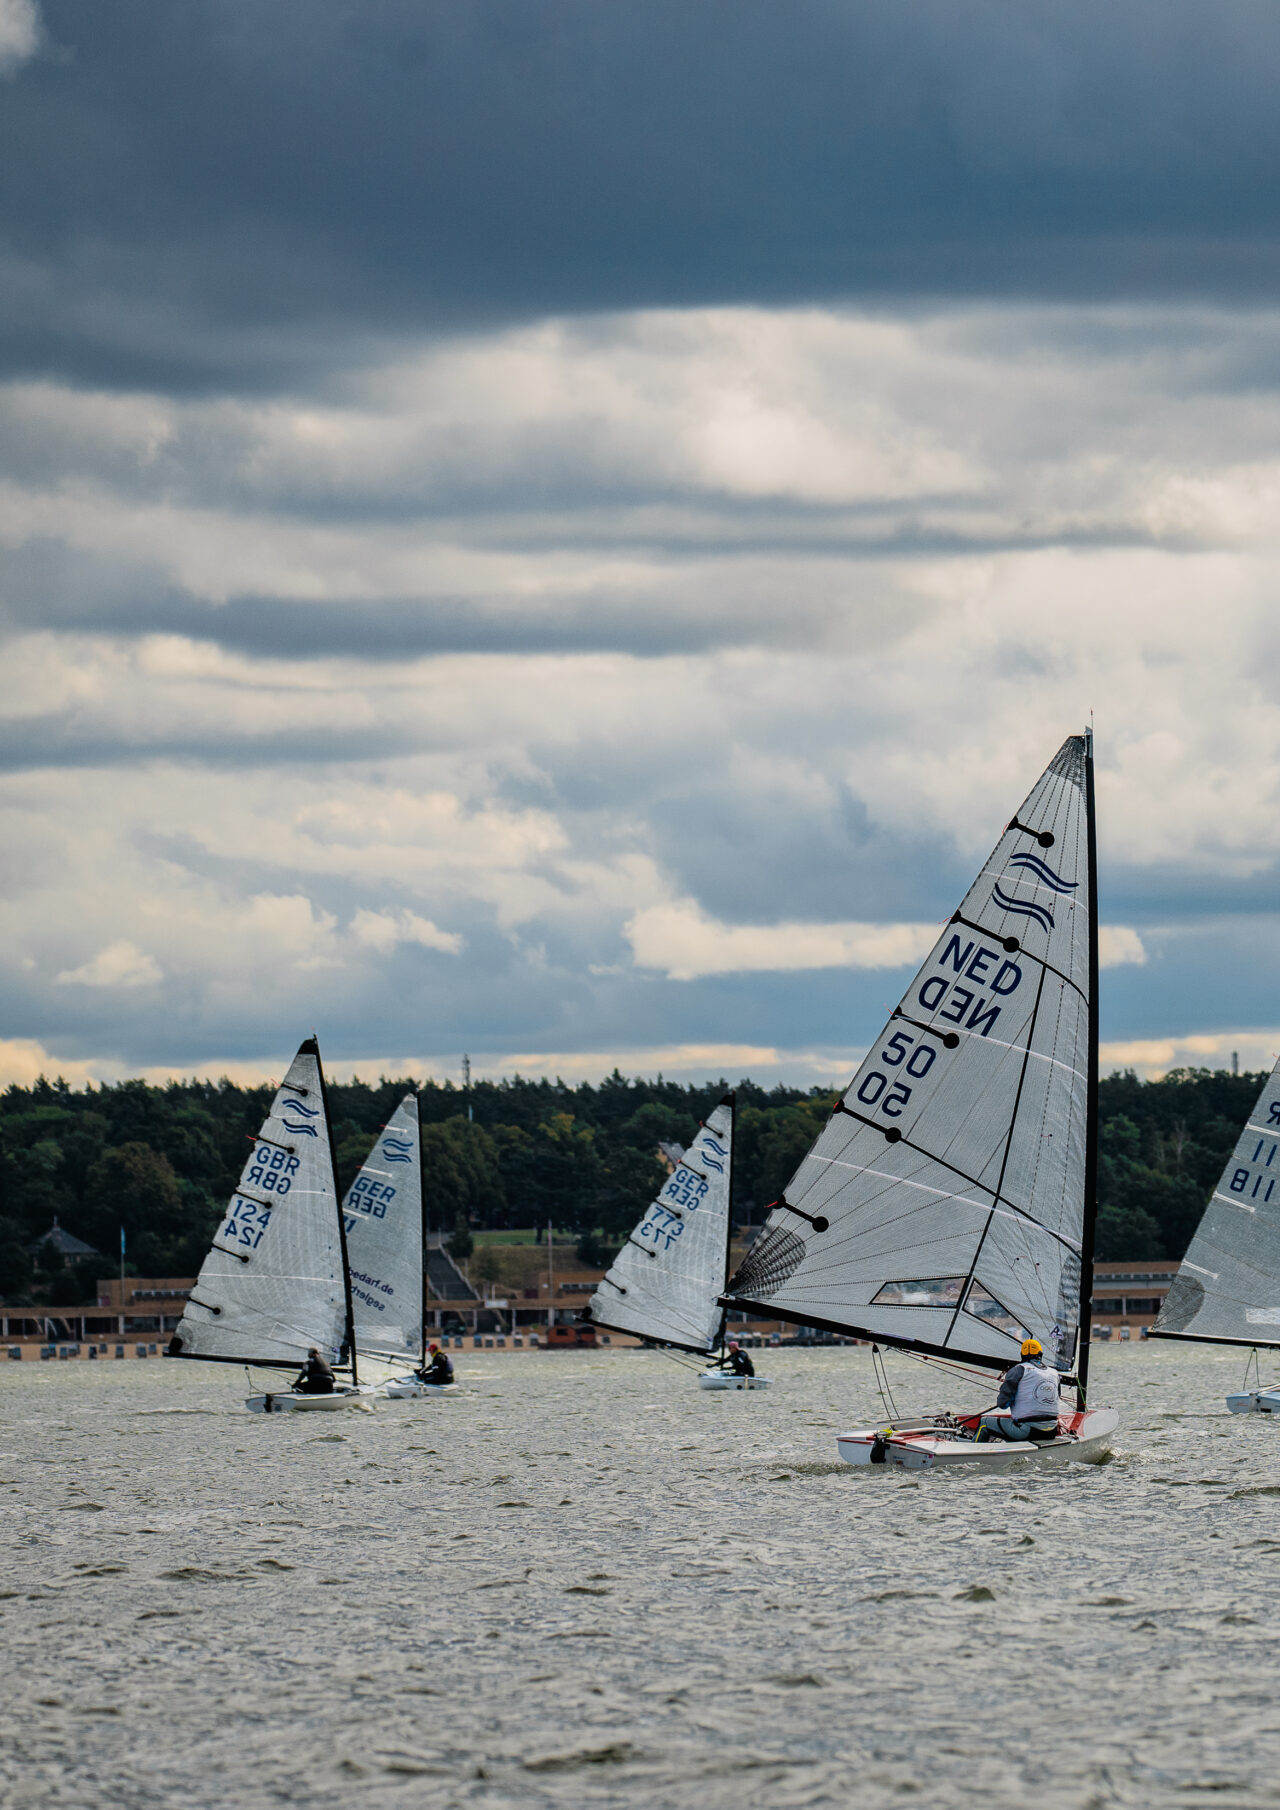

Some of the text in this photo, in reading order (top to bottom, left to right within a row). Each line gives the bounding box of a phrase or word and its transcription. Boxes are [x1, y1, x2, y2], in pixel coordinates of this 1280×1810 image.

[938, 934, 1023, 996] NED
[881, 1030, 936, 1079] 50
[256, 1146, 300, 1177] GBR
[354, 1176, 397, 1203] GER
[676, 1168, 709, 1198] GER
[233, 1199, 272, 1230] 124
[650, 1206, 685, 1237] 773
